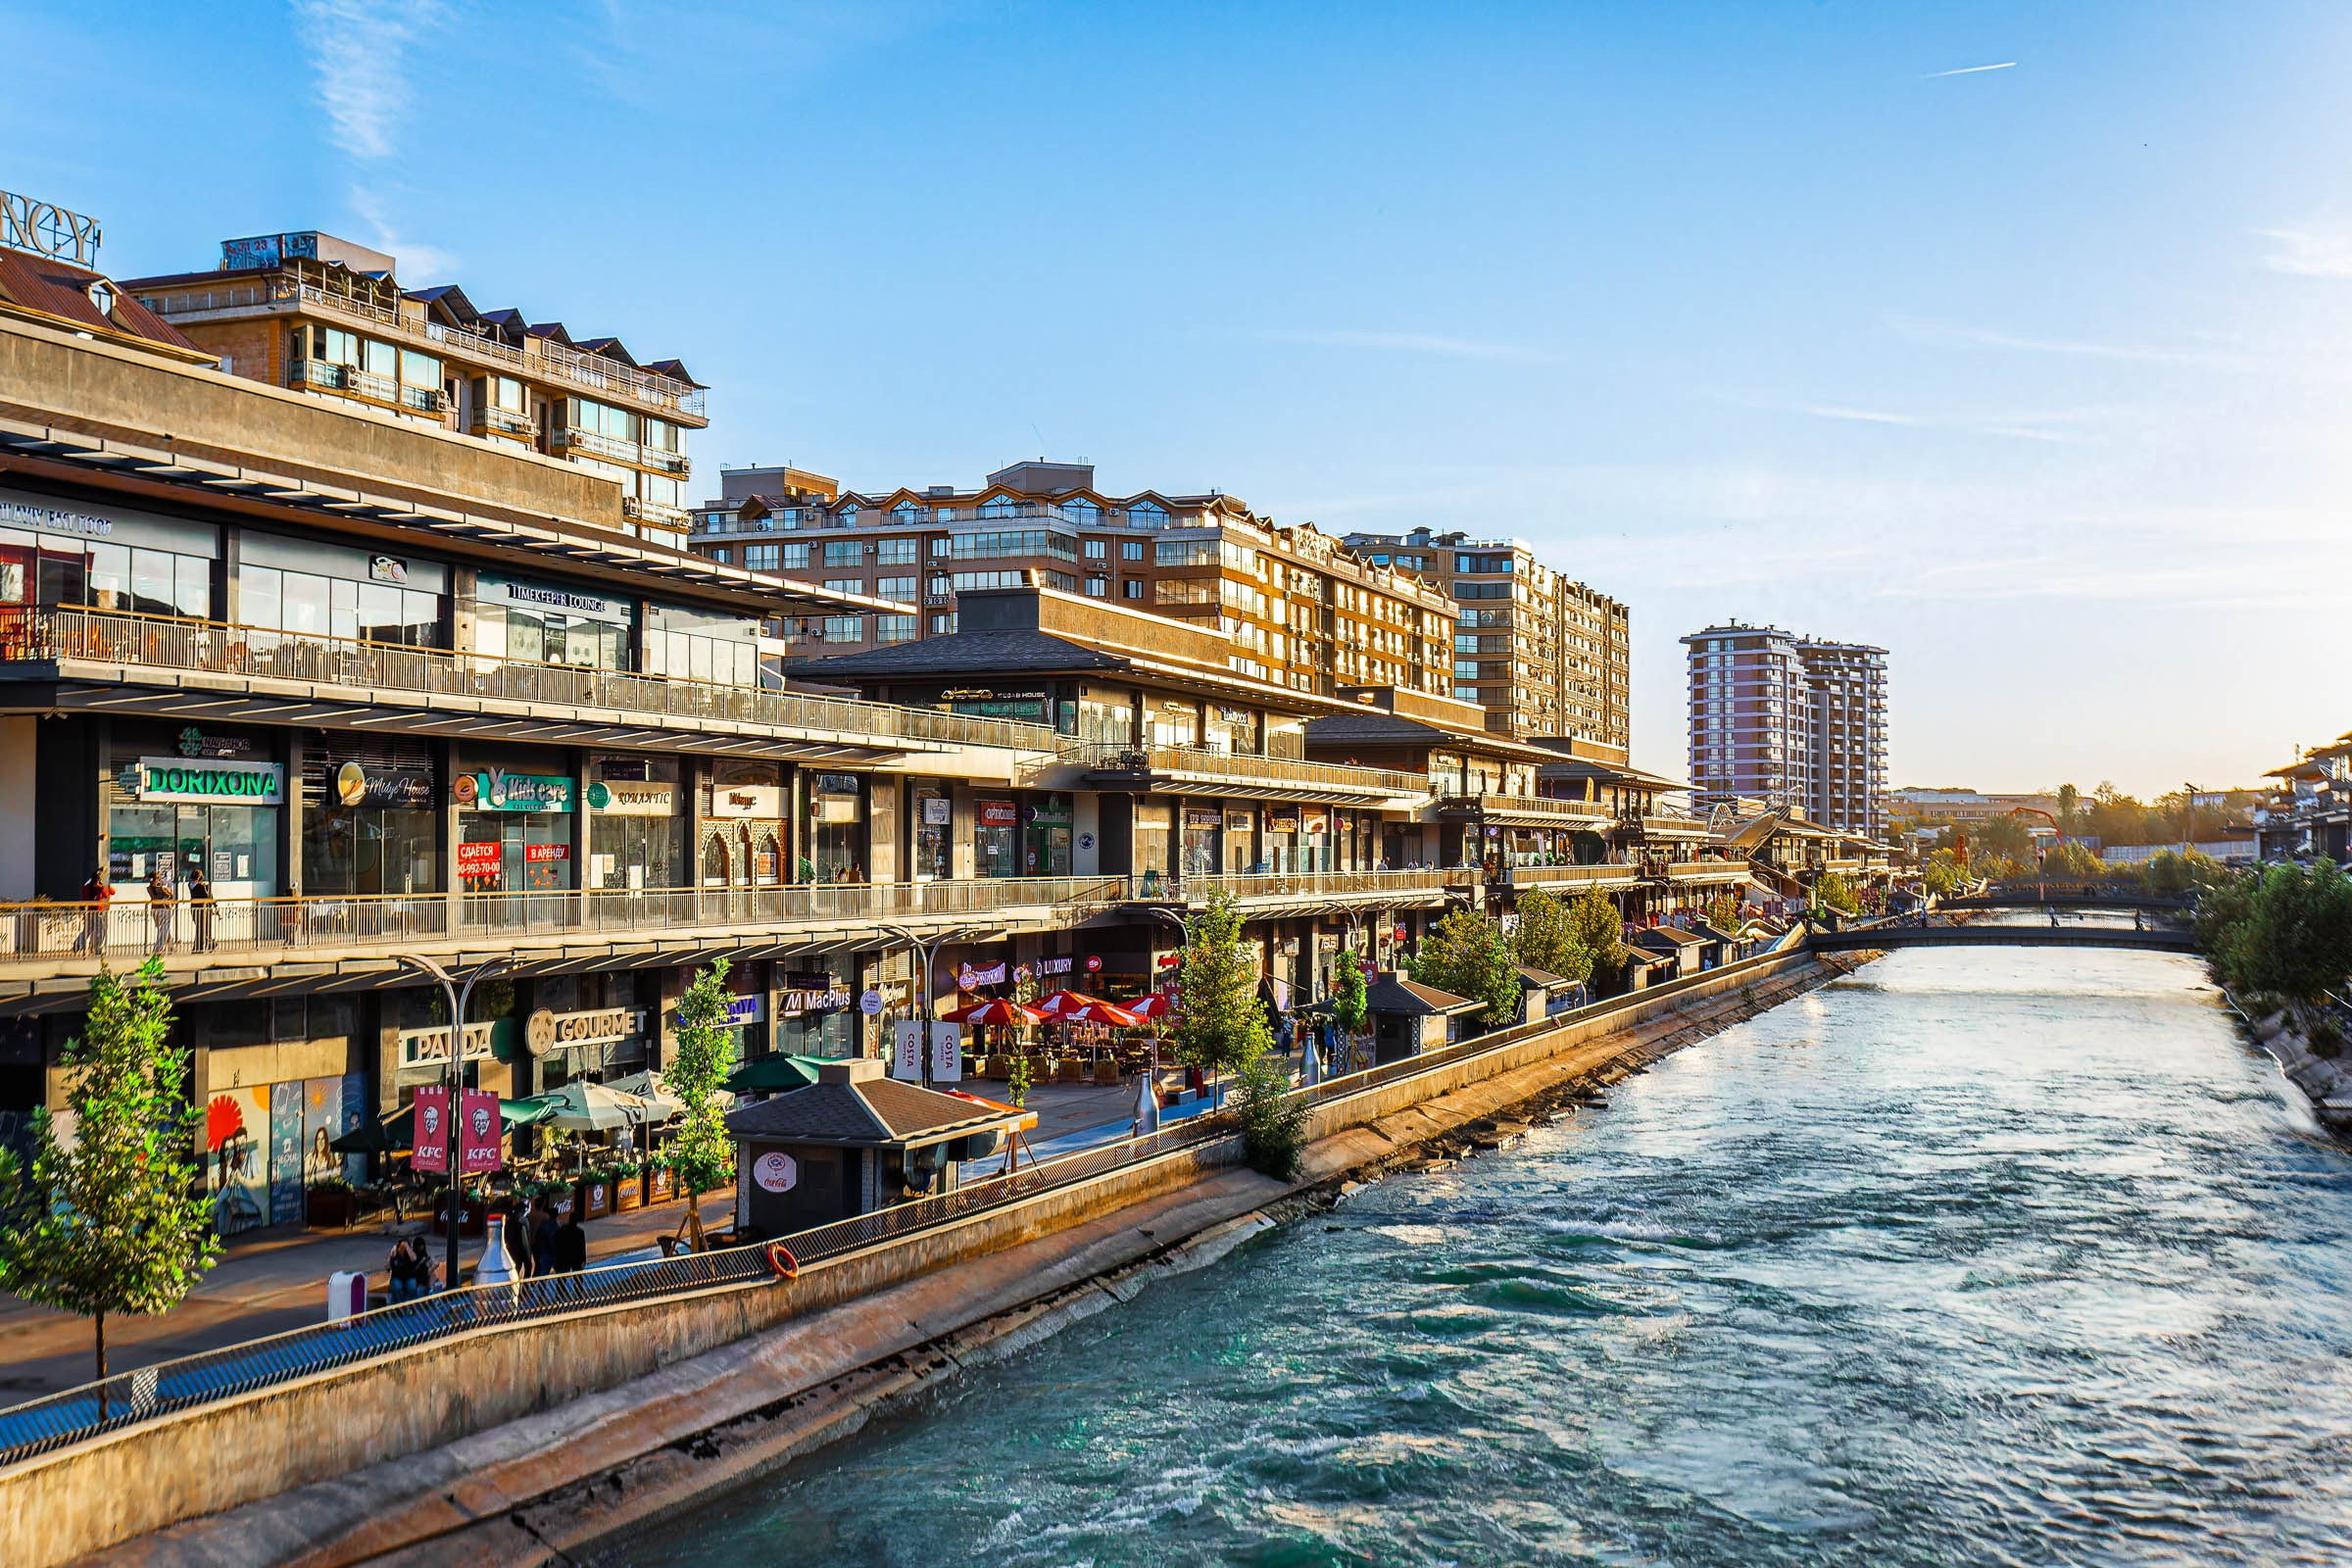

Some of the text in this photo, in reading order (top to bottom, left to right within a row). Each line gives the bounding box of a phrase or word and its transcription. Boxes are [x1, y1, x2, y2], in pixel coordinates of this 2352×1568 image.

[148, 766, 278, 797] DORIXONA
[398, 777, 430, 796] House
[508, 778, 536, 801] Kids
[537, 783, 567, 803] care
[617, 791, 670, 806] ROMANTIC
[530, 848, 565, 859] В АРЕНДУ
[1045, 957, 1073, 974] LUXURY
[806, 988, 851, 1010] MacPlus
[561, 1011, 647, 1042] GOURMET
[906, 1033, 915, 1067] COSTA
[945, 1035, 954, 1069] COSTA
[417, 1146, 443, 1158] KFC
[467, 1149, 497, 1160] KFC
